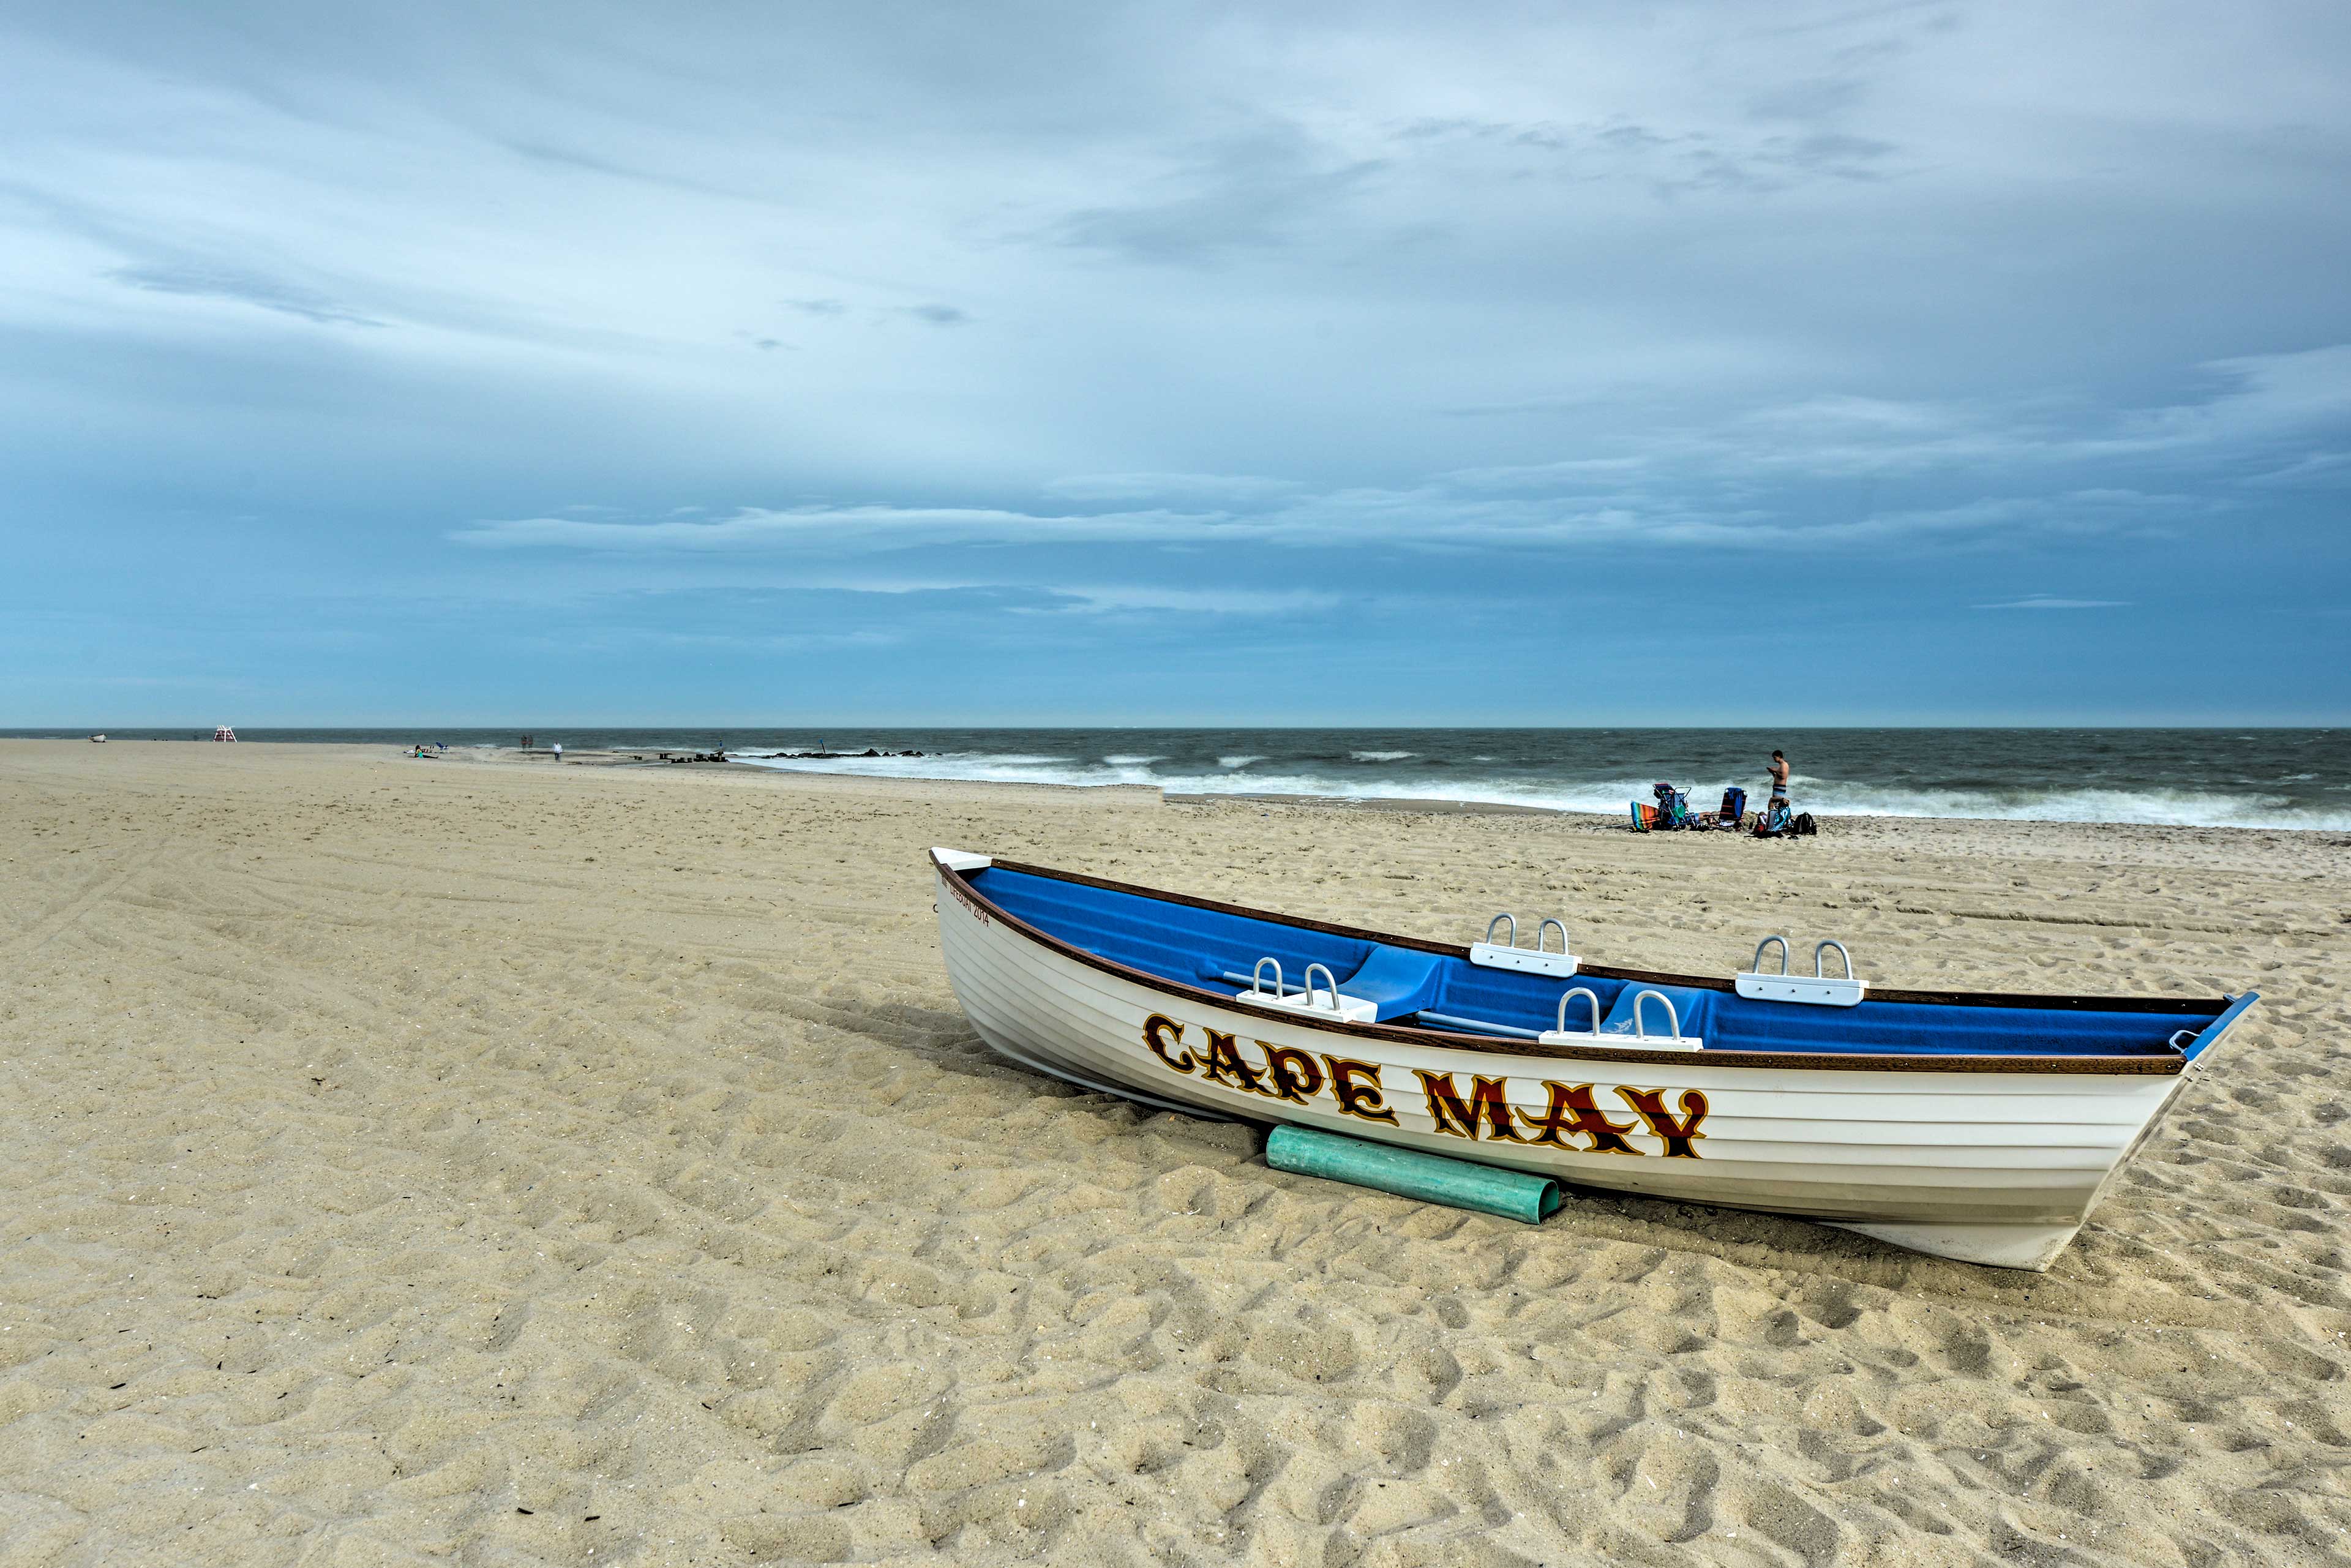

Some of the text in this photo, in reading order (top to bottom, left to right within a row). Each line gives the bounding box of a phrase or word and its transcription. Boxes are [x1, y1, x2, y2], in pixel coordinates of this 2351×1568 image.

[973, 905, 989, 927] 2014
[1142, 1013, 1709, 1159] CAPE MAY
